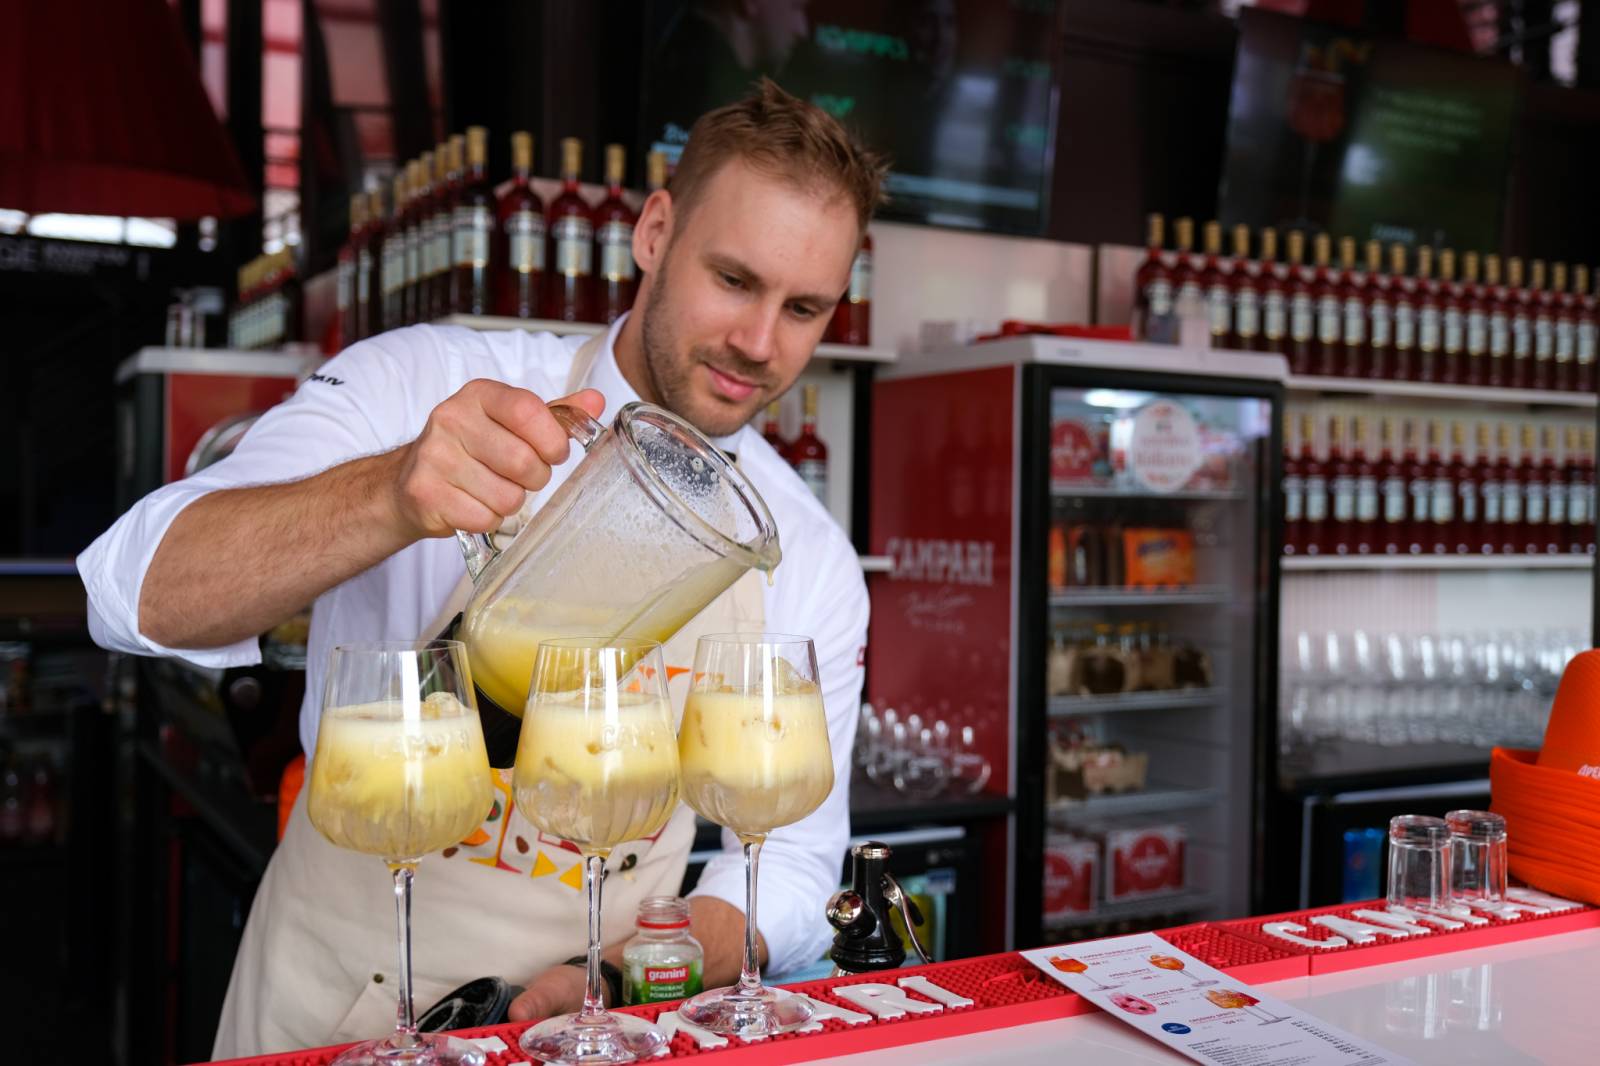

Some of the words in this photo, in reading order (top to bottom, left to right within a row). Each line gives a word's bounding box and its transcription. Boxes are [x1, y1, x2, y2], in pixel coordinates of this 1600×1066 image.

[886, 537, 994, 587] CAMPARI
[1262, 886, 1584, 949] CAMPAR
[648, 968, 686, 981] granini
